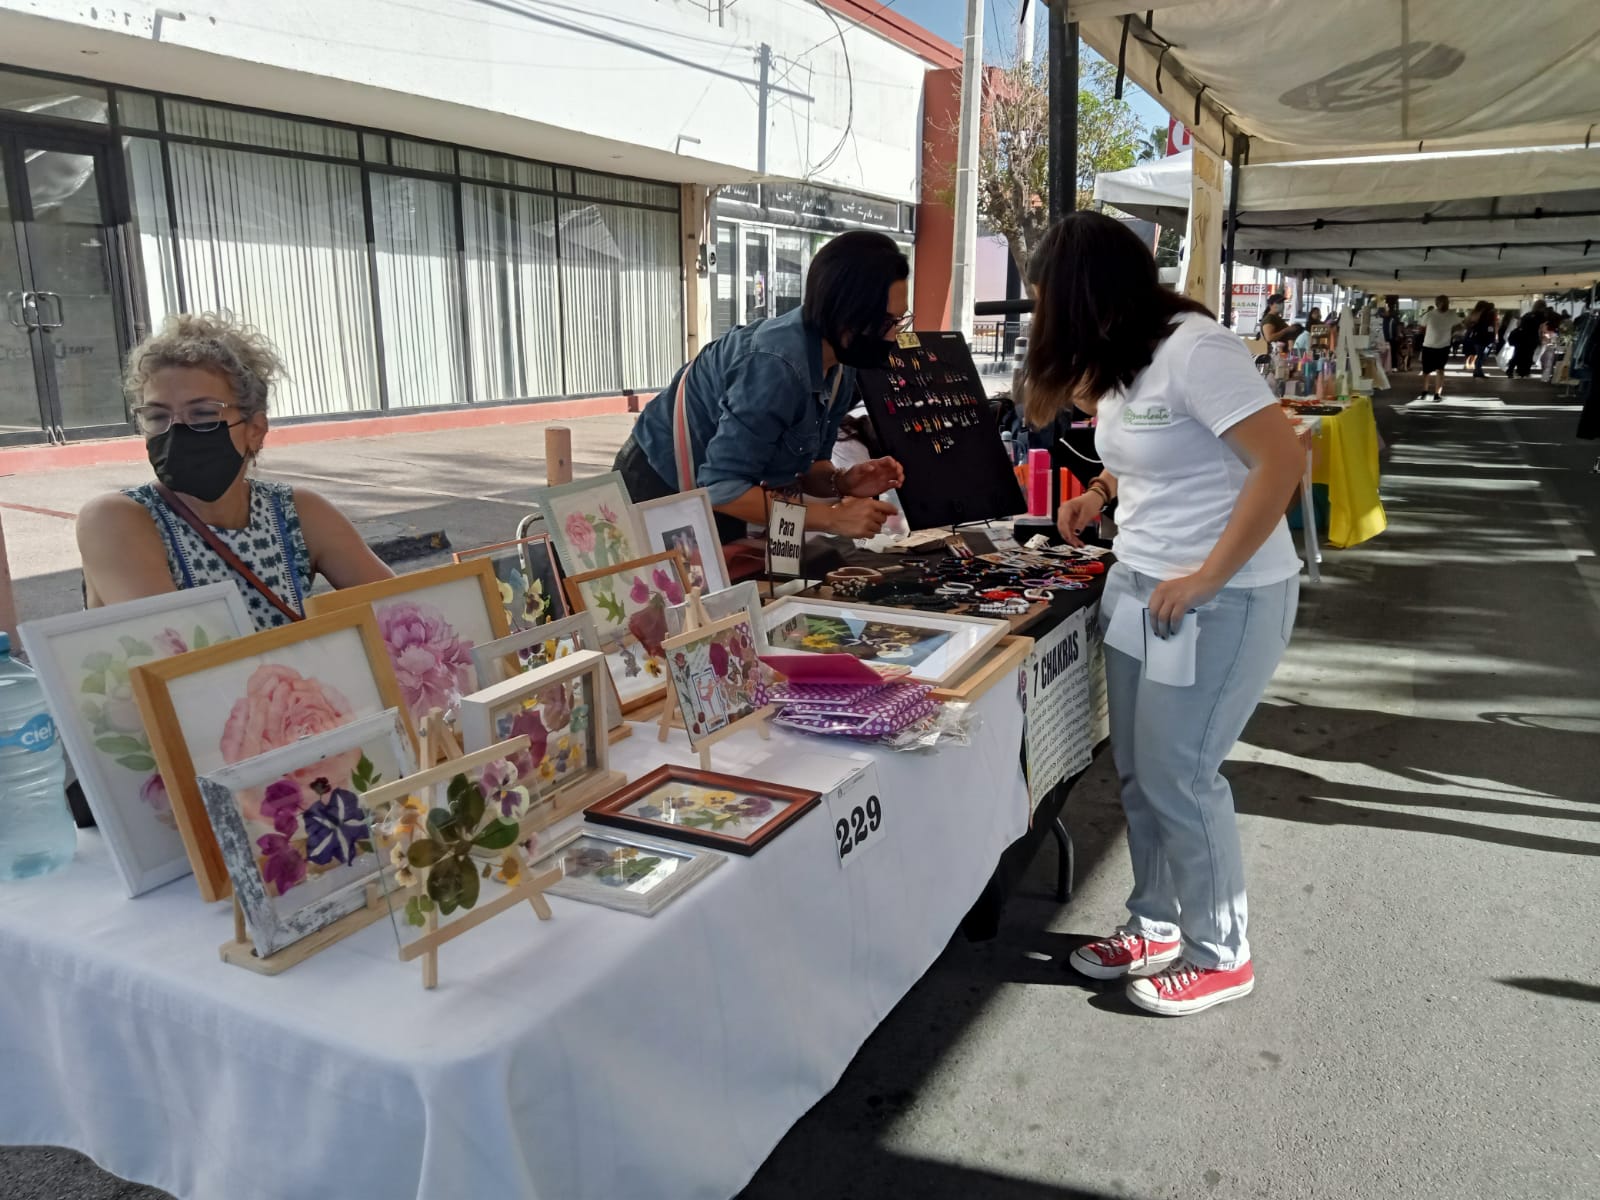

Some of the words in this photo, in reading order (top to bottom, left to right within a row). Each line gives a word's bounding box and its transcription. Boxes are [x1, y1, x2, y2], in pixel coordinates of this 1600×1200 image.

[779, 518, 795, 537] Para
[1033, 661, 1039, 698] 7
[1041, 630, 1079, 690] CHAKRAS
[836, 795, 881, 859] 229
